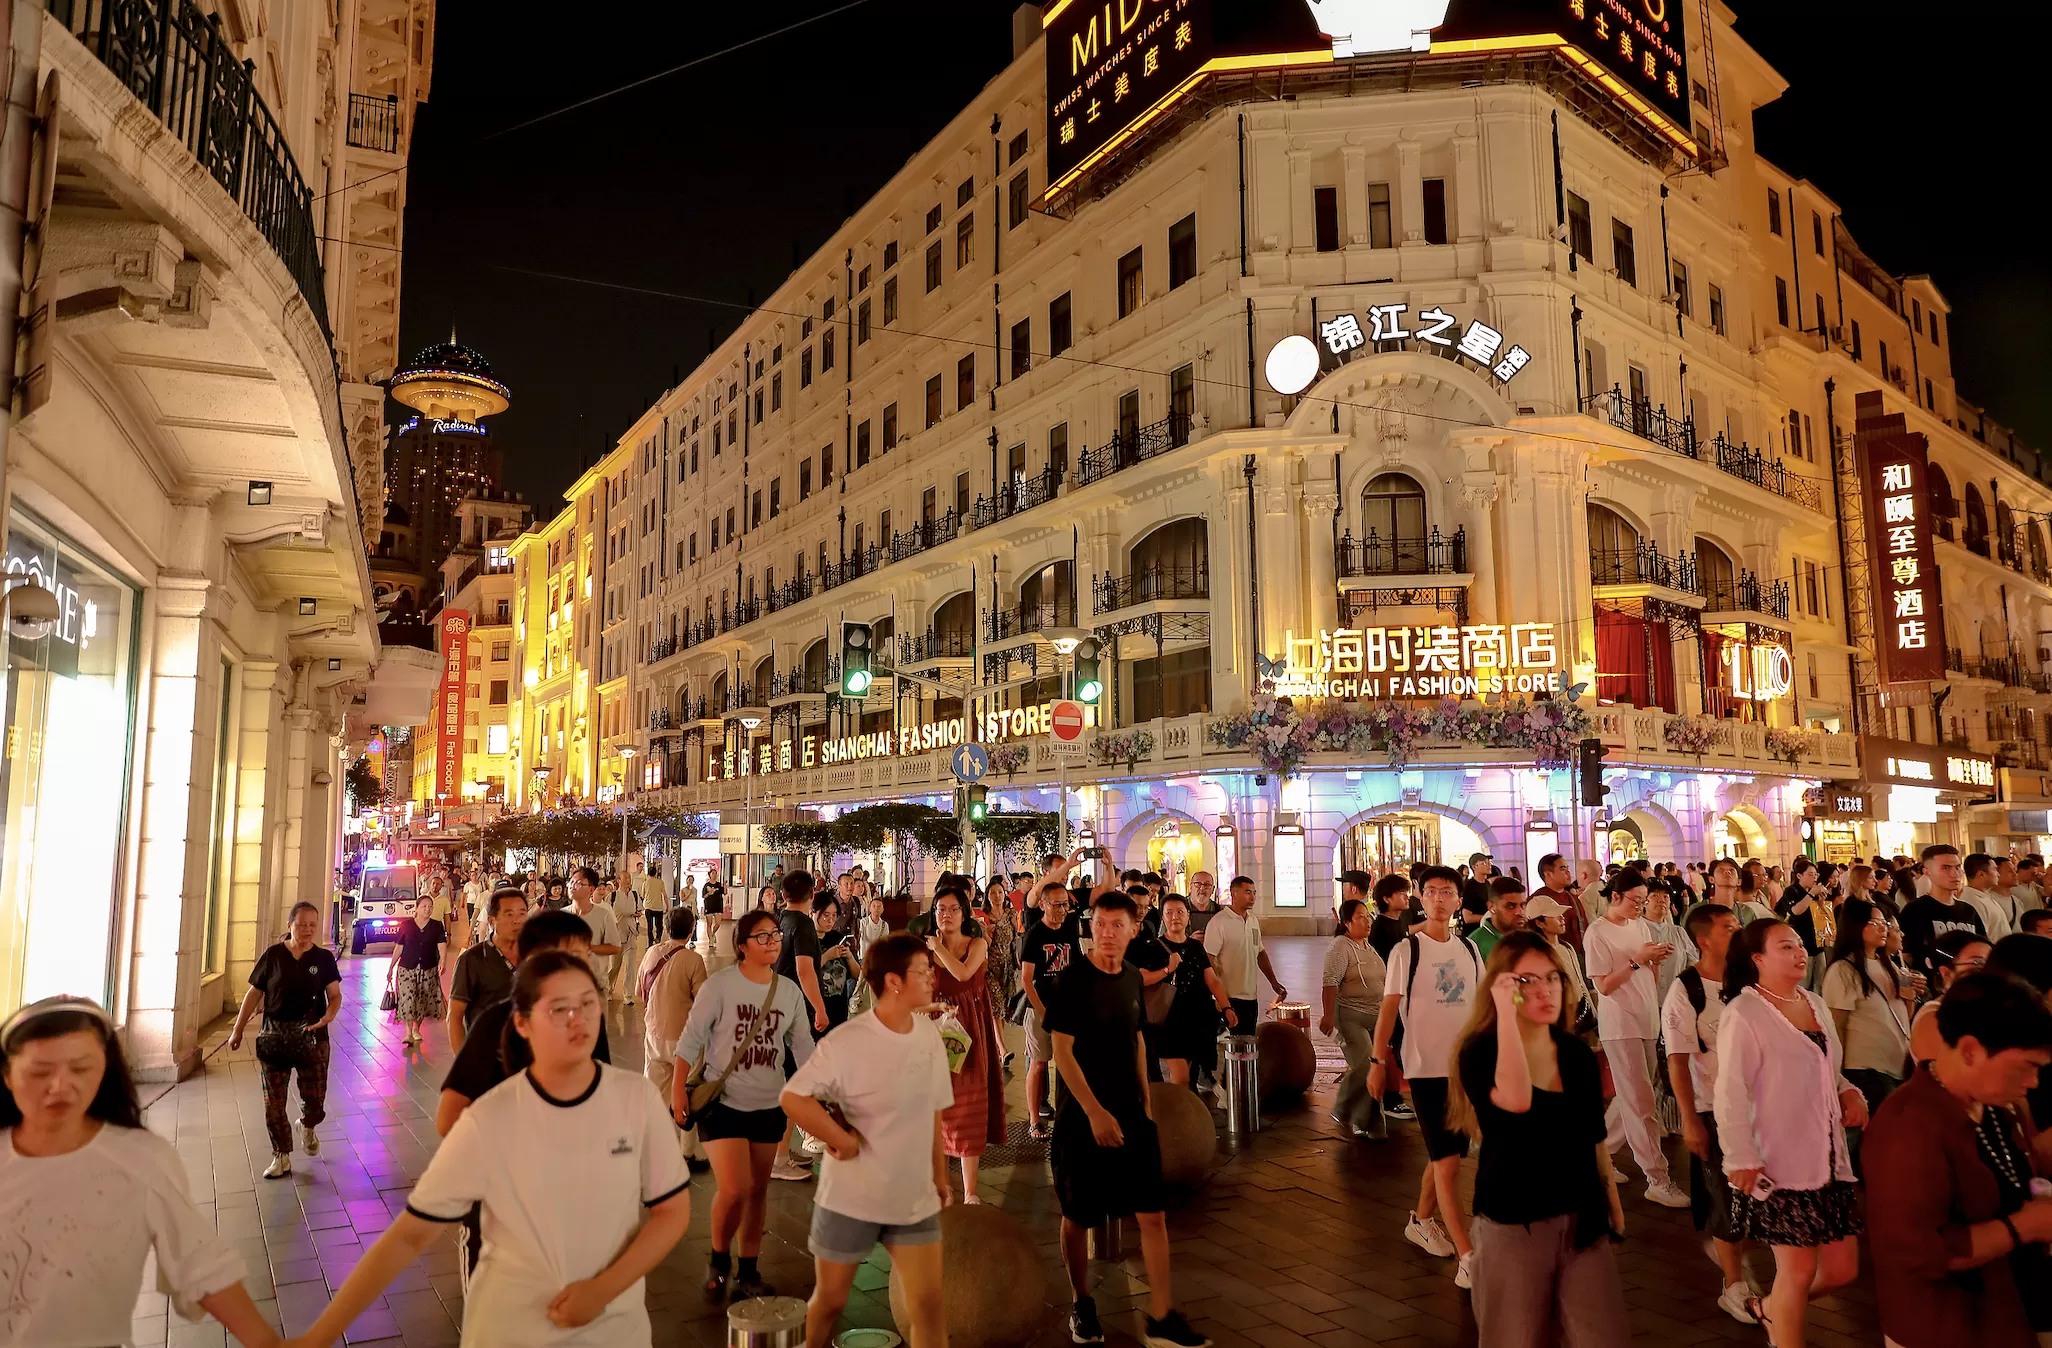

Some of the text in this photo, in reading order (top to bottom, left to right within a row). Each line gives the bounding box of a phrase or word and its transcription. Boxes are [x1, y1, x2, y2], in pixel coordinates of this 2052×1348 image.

[1054, 85, 1083, 117] SWISS
[1085, 42, 1132, 89] WATCHES
[1136, 9, 1171, 45] SINCE
[1072, 0, 1161, 76] MID
[1635, 19, 1662, 49] SINCE
[1664, 44, 1682, 67] 1918
[1060, 20, 1192, 144] 瑞士美度表
[1320, 303, 1503, 367] 锦江之星
[433, 418, 480, 434] Radisson
[1882, 464, 1926, 650] 和颐至尊酒店
[1284, 622, 1557, 675] 上海时装商店
[1274, 673, 1559, 699] SHANGHAI FASHION STORE
[821, 730, 891, 764] SHANGHAI
[986, 703, 1050, 744] STORE
